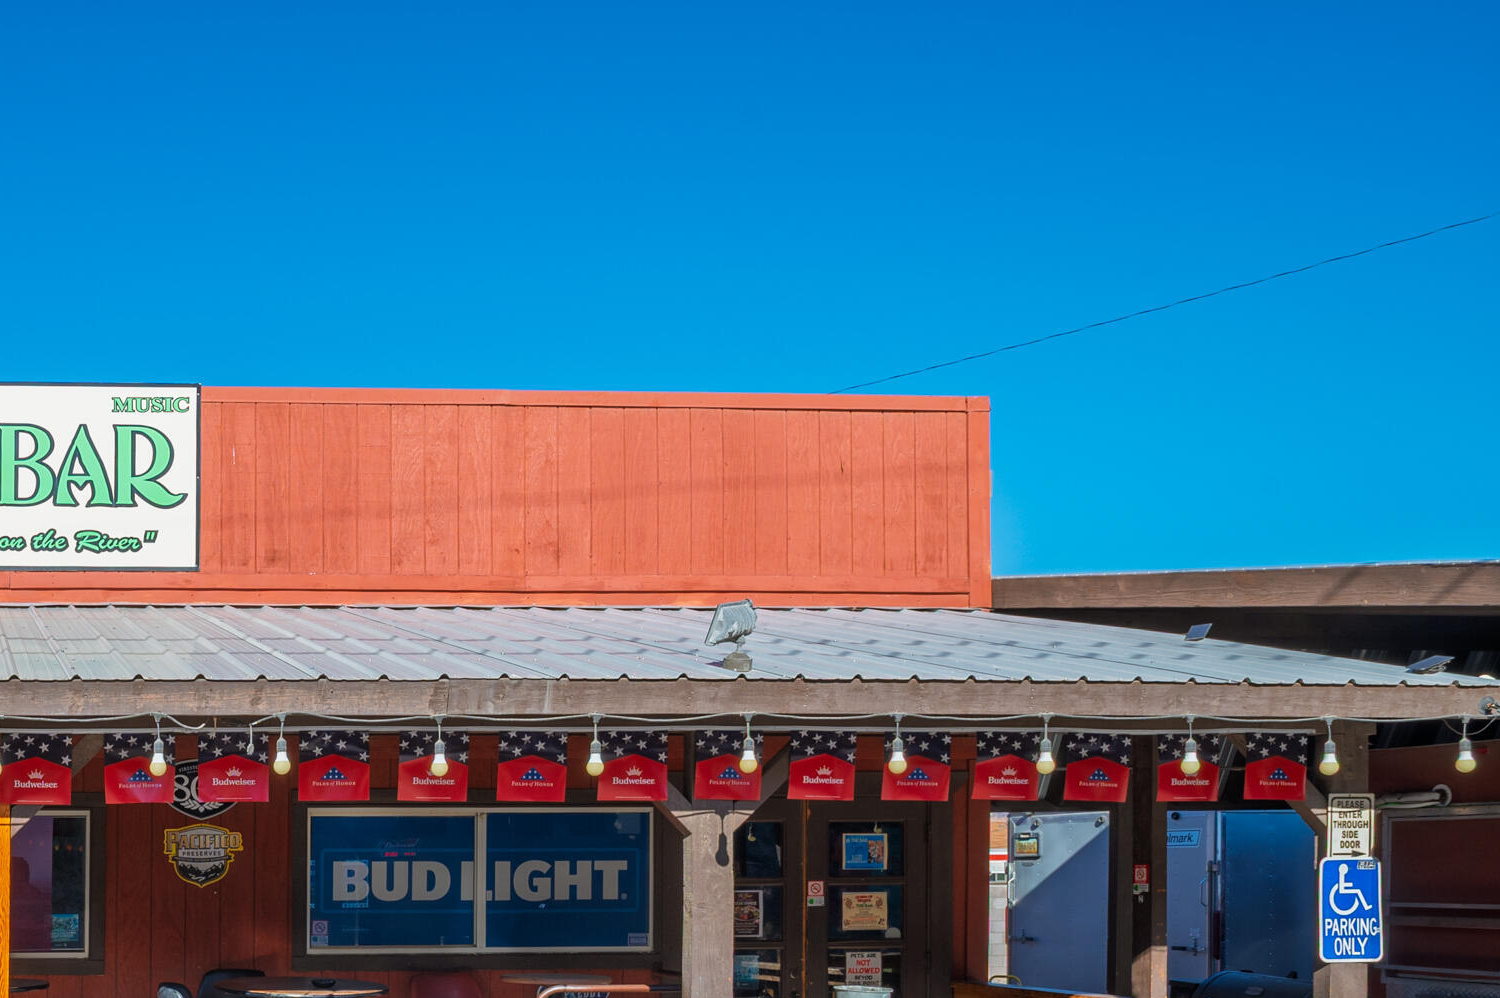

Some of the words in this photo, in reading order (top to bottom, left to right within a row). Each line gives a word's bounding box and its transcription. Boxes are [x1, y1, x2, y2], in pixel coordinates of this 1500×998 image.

[112, 396, 190, 413] MUSIC
[26, 529, 69, 552] the
[1337, 800, 1364, 808] PLEASE
[1333, 820, 1368, 828] THROUGH
[167, 831, 240, 852] PACIFICO
[1341, 830, 1358, 838] SIDE
[1340, 840, 1360, 848] DOOR
[333, 860, 451, 902] BUD
[1325, 918, 1377, 936] PARKING
[1334, 937, 1368, 955] ONLY
